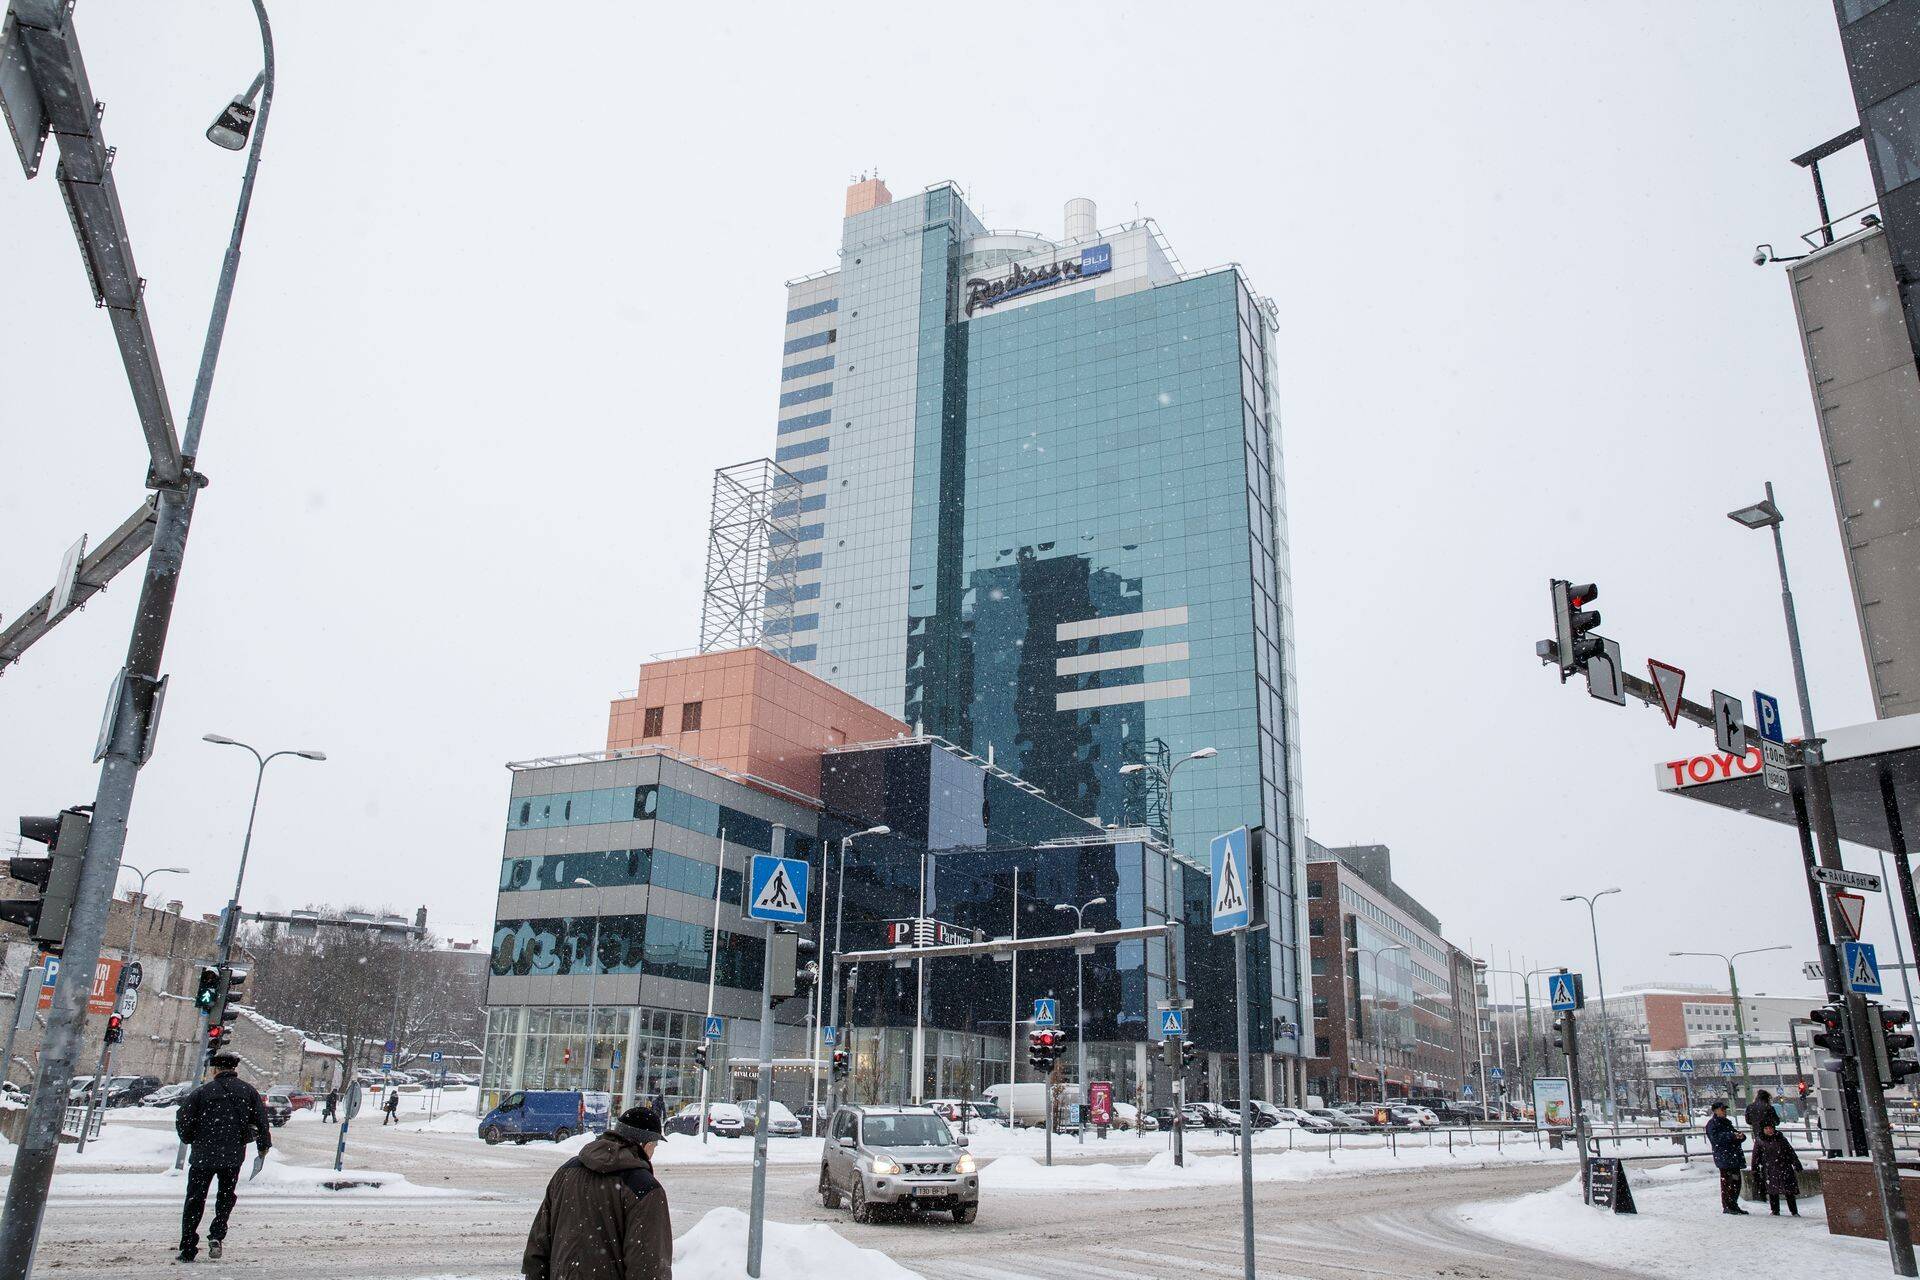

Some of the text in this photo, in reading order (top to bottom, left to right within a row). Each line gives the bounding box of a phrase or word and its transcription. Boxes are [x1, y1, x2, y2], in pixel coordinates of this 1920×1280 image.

[1082, 253, 1108, 267] BLU
[1760, 698, 1775, 735] P
[1666, 746, 1763, 786] TOYO
[894, 922, 910, 943] P
[940, 925, 971, 945] Partner
[46, 961, 60, 981] P
[95, 963, 111, 980] KRI
